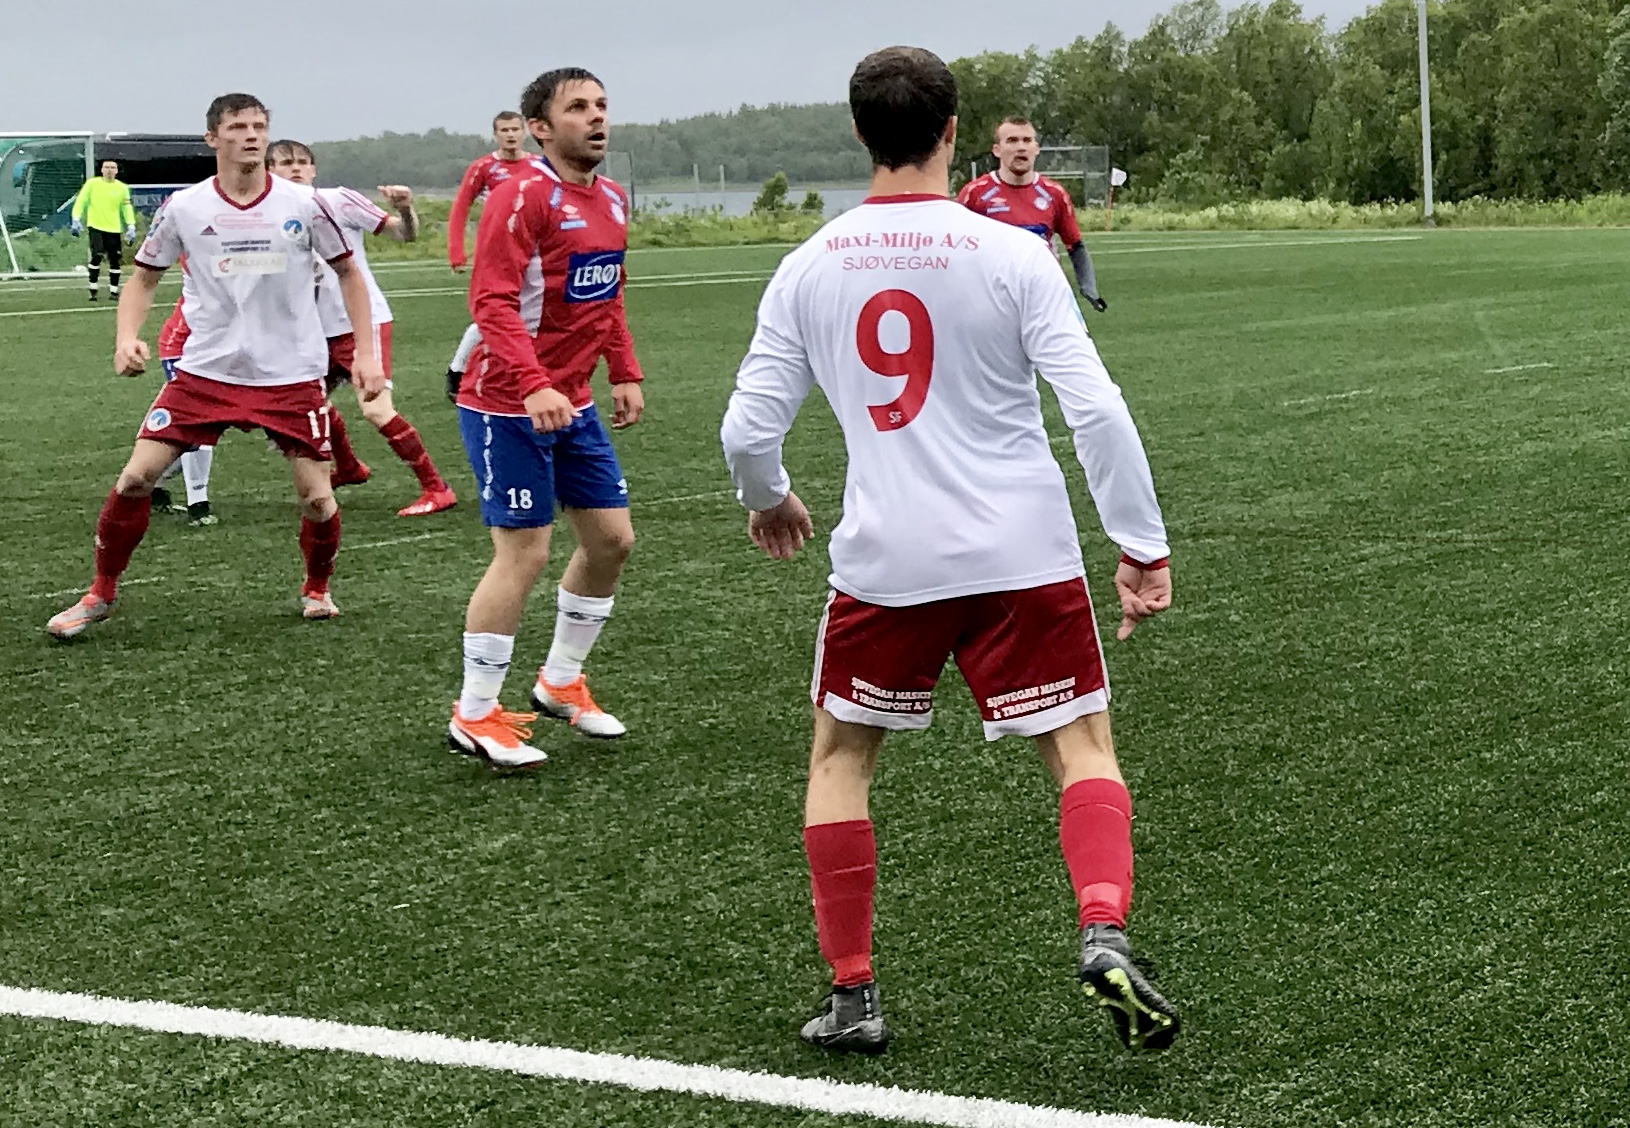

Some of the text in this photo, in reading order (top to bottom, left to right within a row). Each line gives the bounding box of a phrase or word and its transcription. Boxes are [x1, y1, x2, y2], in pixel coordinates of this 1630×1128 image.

[825, 232, 979, 253] Maxi-Miljø A/S
[842, 256, 949, 270] SJØVEGAN
[856, 289, 934, 431] 9
[506, 487, 533, 509] 18
[1002, 695, 1058, 717] TRANSPORT
